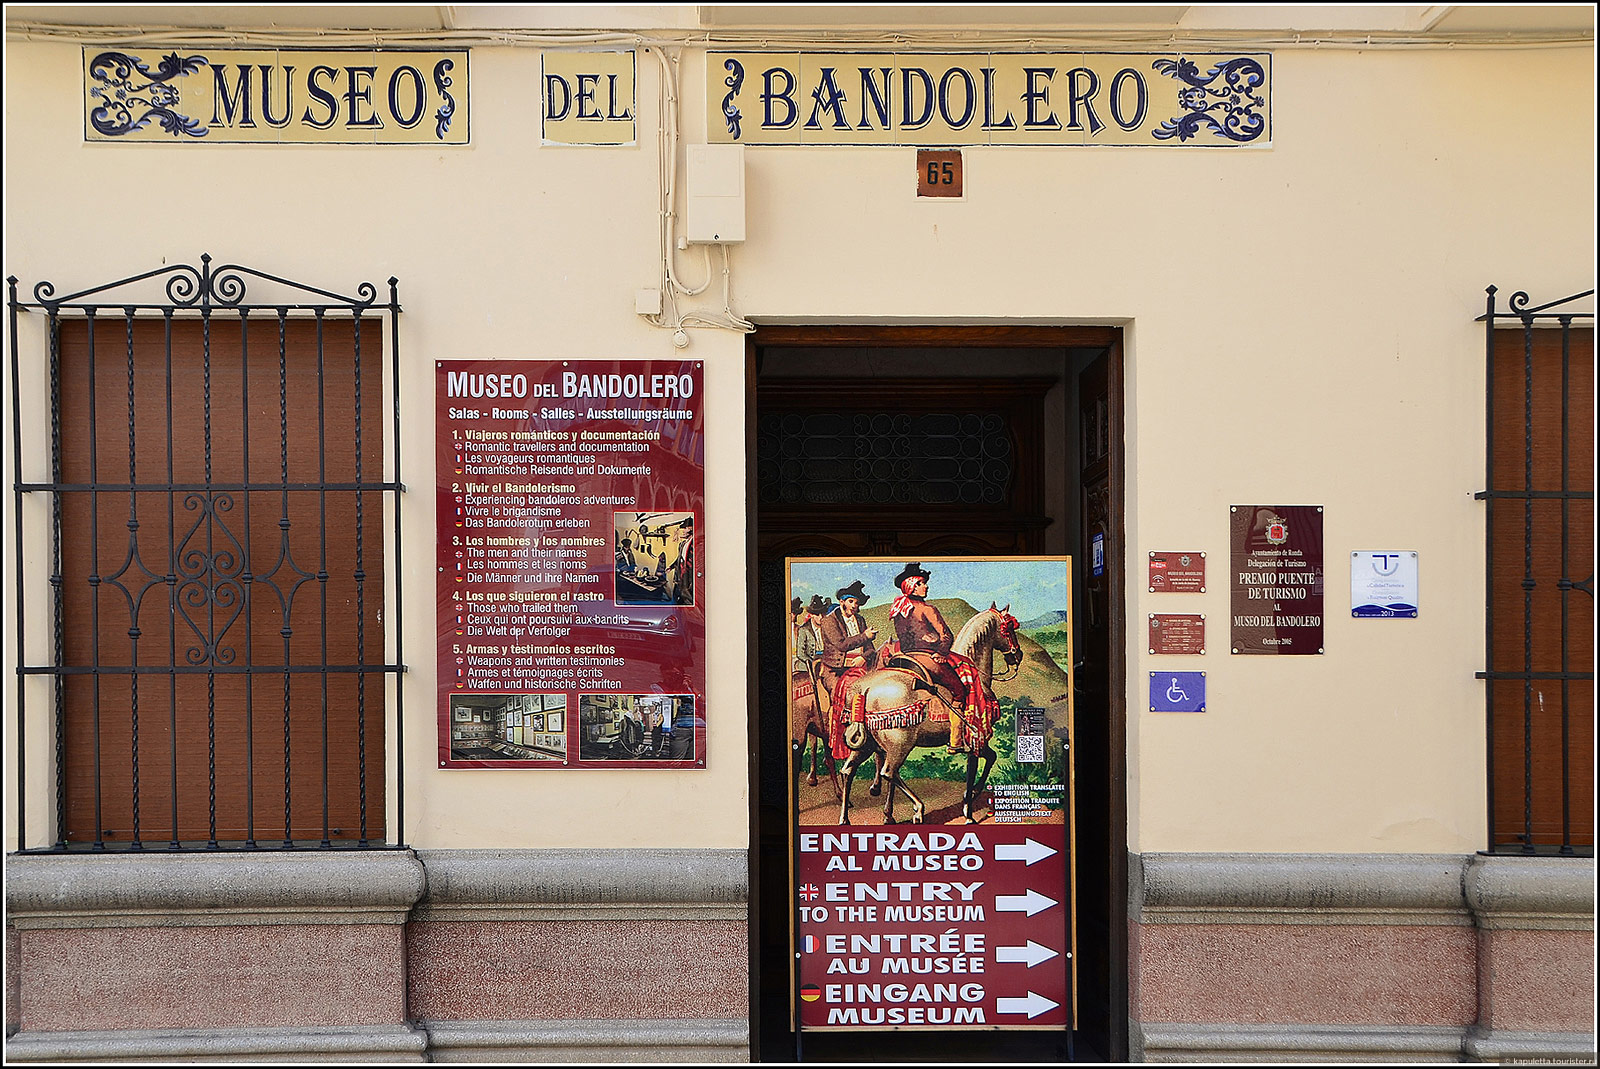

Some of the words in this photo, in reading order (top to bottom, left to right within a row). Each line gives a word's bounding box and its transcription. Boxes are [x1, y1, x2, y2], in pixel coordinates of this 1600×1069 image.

[209, 63, 427, 129] MUSEO
[545, 74, 634, 122] DEL
[760, 67, 1149, 138] BANDOLERO
[927, 162, 953, 186] 65
[448, 371, 527, 398] MUSEO
[534, 384, 558, 398] DEL
[562, 371, 693, 398] BANDOLERO
[449, 408, 479, 419] Salas
[492, 408, 528, 419] Rooms
[541, 408, 575, 419] Salles
[587, 408, 692, 421] Ausstellungsräume
[452, 430, 462, 440] 1.
[465, 430, 507, 442] Viajeros
[511, 430, 569, 440] románticos
[572, 432, 577, 442] y
[580, 430, 660, 440] documentación
[465, 442, 510, 451] Romantic
[513, 442, 556, 451] travellers
[559, 442, 575, 451] and
[579, 442, 649, 451] documentation
[465, 453, 482, 463] Les
[485, 455, 534, 465] voyageurs
[537, 453, 595, 465] romantiques
[465, 465, 527, 474] Romantische
[530, 465, 574, 474] Reisende
[577, 465, 594, 474] und
[598, 465, 650, 474] Dokumente
[452, 484, 462, 493] 2.
[466, 483, 489, 493] Vivir
[492, 483, 502, 493] el
[505, 483, 575, 493] Bandolerismo
[465, 495, 525, 506] Experiencing
[528, 495, 580, 504] bandoleros
[584, 495, 635, 504] adventures
[465, 507, 489, 516] Vivre
[492, 507, 500, 516] le
[503, 507, 561, 517] brigandisme
[465, 518, 483, 527] Das
[487, 518, 552, 527] Bandolerotum
[555, 518, 590, 527] erleben
[452, 537, 462, 545] 3.
[466, 536, 483, 545] Los
[487, 536, 530, 545] hombres
[534, 539, 539, 547] y
[542, 536, 558, 545] los
[561, 536, 605, 545] nombres
[467, 548, 484, 558] The
[488, 548, 508, 558] men
[511, 548, 528, 558] and
[532, 548, 552, 558] their
[467, 560, 484, 569] Les
[487, 560, 529, 569] hommes
[532, 560, 540, 569] et
[543, 560, 556, 569] les
[1248, 559, 1276, 569] Delegación
[467, 573, 482, 582] Die
[486, 573, 521, 582] Männer
[524, 573, 542, 582] und
[545, 573, 563, 582] ihre
[566, 573, 599, 582] Namen
[1239, 573, 1276, 584] PREMIO
[1279, 573, 1314, 584] PUENTE
[452, 592, 462, 601] 4.
[466, 592, 483, 601] Los
[487, 594, 505, 602] que
[509, 592, 556, 602] siguieron
[561, 592, 570, 601] el
[574, 592, 604, 601] rastro
[1248, 588, 1261, 599] DE
[1263, 588, 1306, 599] TURISMO
[467, 603, 496, 613] Those
[500, 603, 519, 613] who
[522, 603, 551, 613] trailed
[554, 603, 578, 613] them
[467, 615, 491, 624] Ceux
[494, 615, 508, 626] qui
[511, 616, 526, 624] ont
[529, 615, 572, 626] poursuivi
[595, 615, 629, 624] bandits
[1234, 616, 1260, 626] MUSEO
[1261, 616, 1275, 626] DEL
[1276, 616, 1320, 626] BANDOLERO
[467, 626, 483, 636] Die
[486, 626, 507, 636] Welt
[510, 626, 524, 636] der
[527, 626, 570, 637] Verfolger
[453, 645, 463, 654] 5.
[466, 645, 498, 654] Armas
[502, 647, 507, 656] y
[510, 645, 570, 654] testimonios
[574, 645, 615, 654] escritos
[468, 656, 511, 667] Weapons
[515, 656, 532, 665] and
[535, 656, 567, 665] written
[570, 656, 624, 665] testimonies
[467, 668, 498, 677] Armes
[502, 669, 510, 677] et
[513, 668, 573, 679] témoignages
[577, 668, 602, 677] écrits
[468, 679, 501, 688] Waffen
[504, 679, 521, 688] und
[524, 679, 576, 688] historische
[579, 679, 621, 688] Schriften
[801, 833, 984, 852] ENTRADA
[826, 855, 862, 871] AL
[872, 855, 983, 871] MUSEO
[826, 882, 985, 901] ENTRY
[800, 906, 828, 922] TO
[836, 906, 877, 922] THE
[885, 906, 985, 922] MUSEUM
[826, 928, 986, 953] ENTRÉE
[826, 958, 870, 974] AU
[881, 952, 985, 974] MUSÉE
[826, 983, 985, 1003] EINGANG
[828, 1007, 986, 1024] MUSEUM
